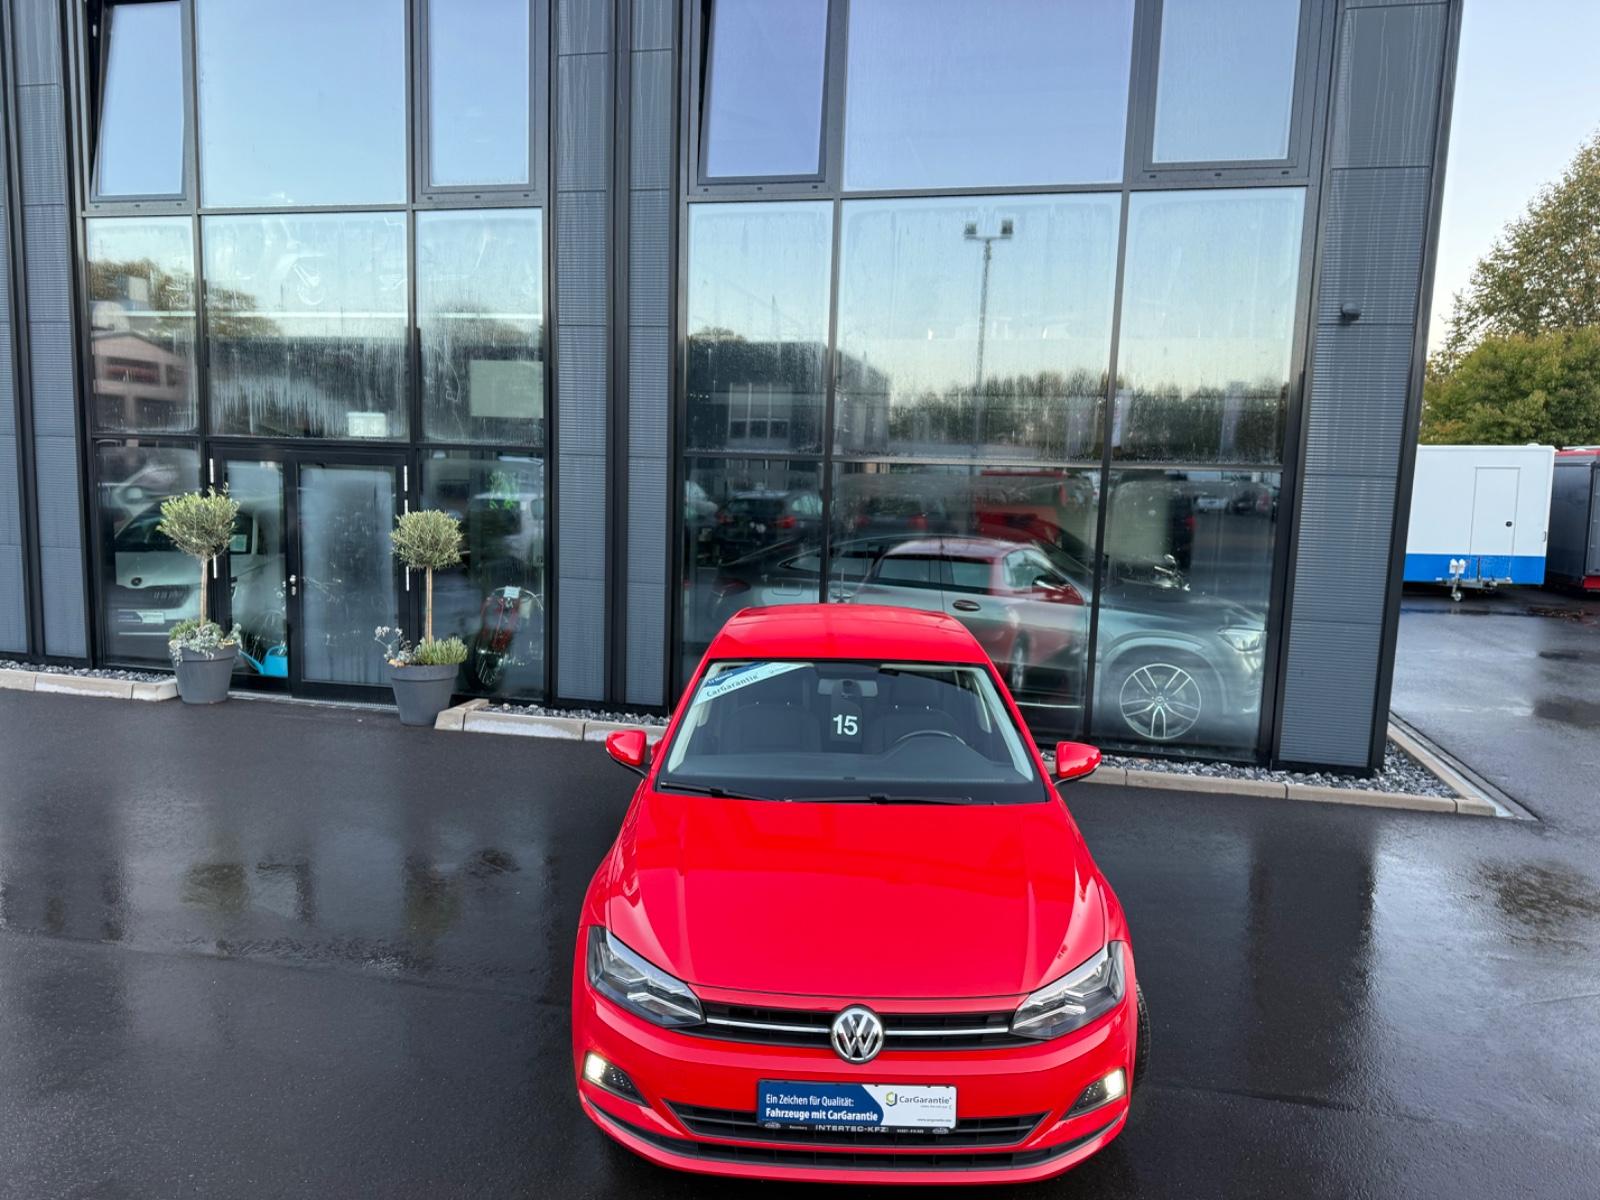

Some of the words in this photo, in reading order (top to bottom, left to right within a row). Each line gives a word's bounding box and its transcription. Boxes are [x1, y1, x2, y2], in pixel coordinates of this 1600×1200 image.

[833, 714, 858, 736] 15
[832, 1007, 884, 1063] VW
[765, 1094, 778, 1104] Ein
[779, 1094, 808, 1105] Zeichen
[809, 1095, 820, 1106] für
[821, 1096, 854, 1107] Qualität:
[765, 1108, 810, 1120] Fahrzeuge
[811, 1110, 826, 1119] mit
[827, 1110, 878, 1121] CarGarantie
